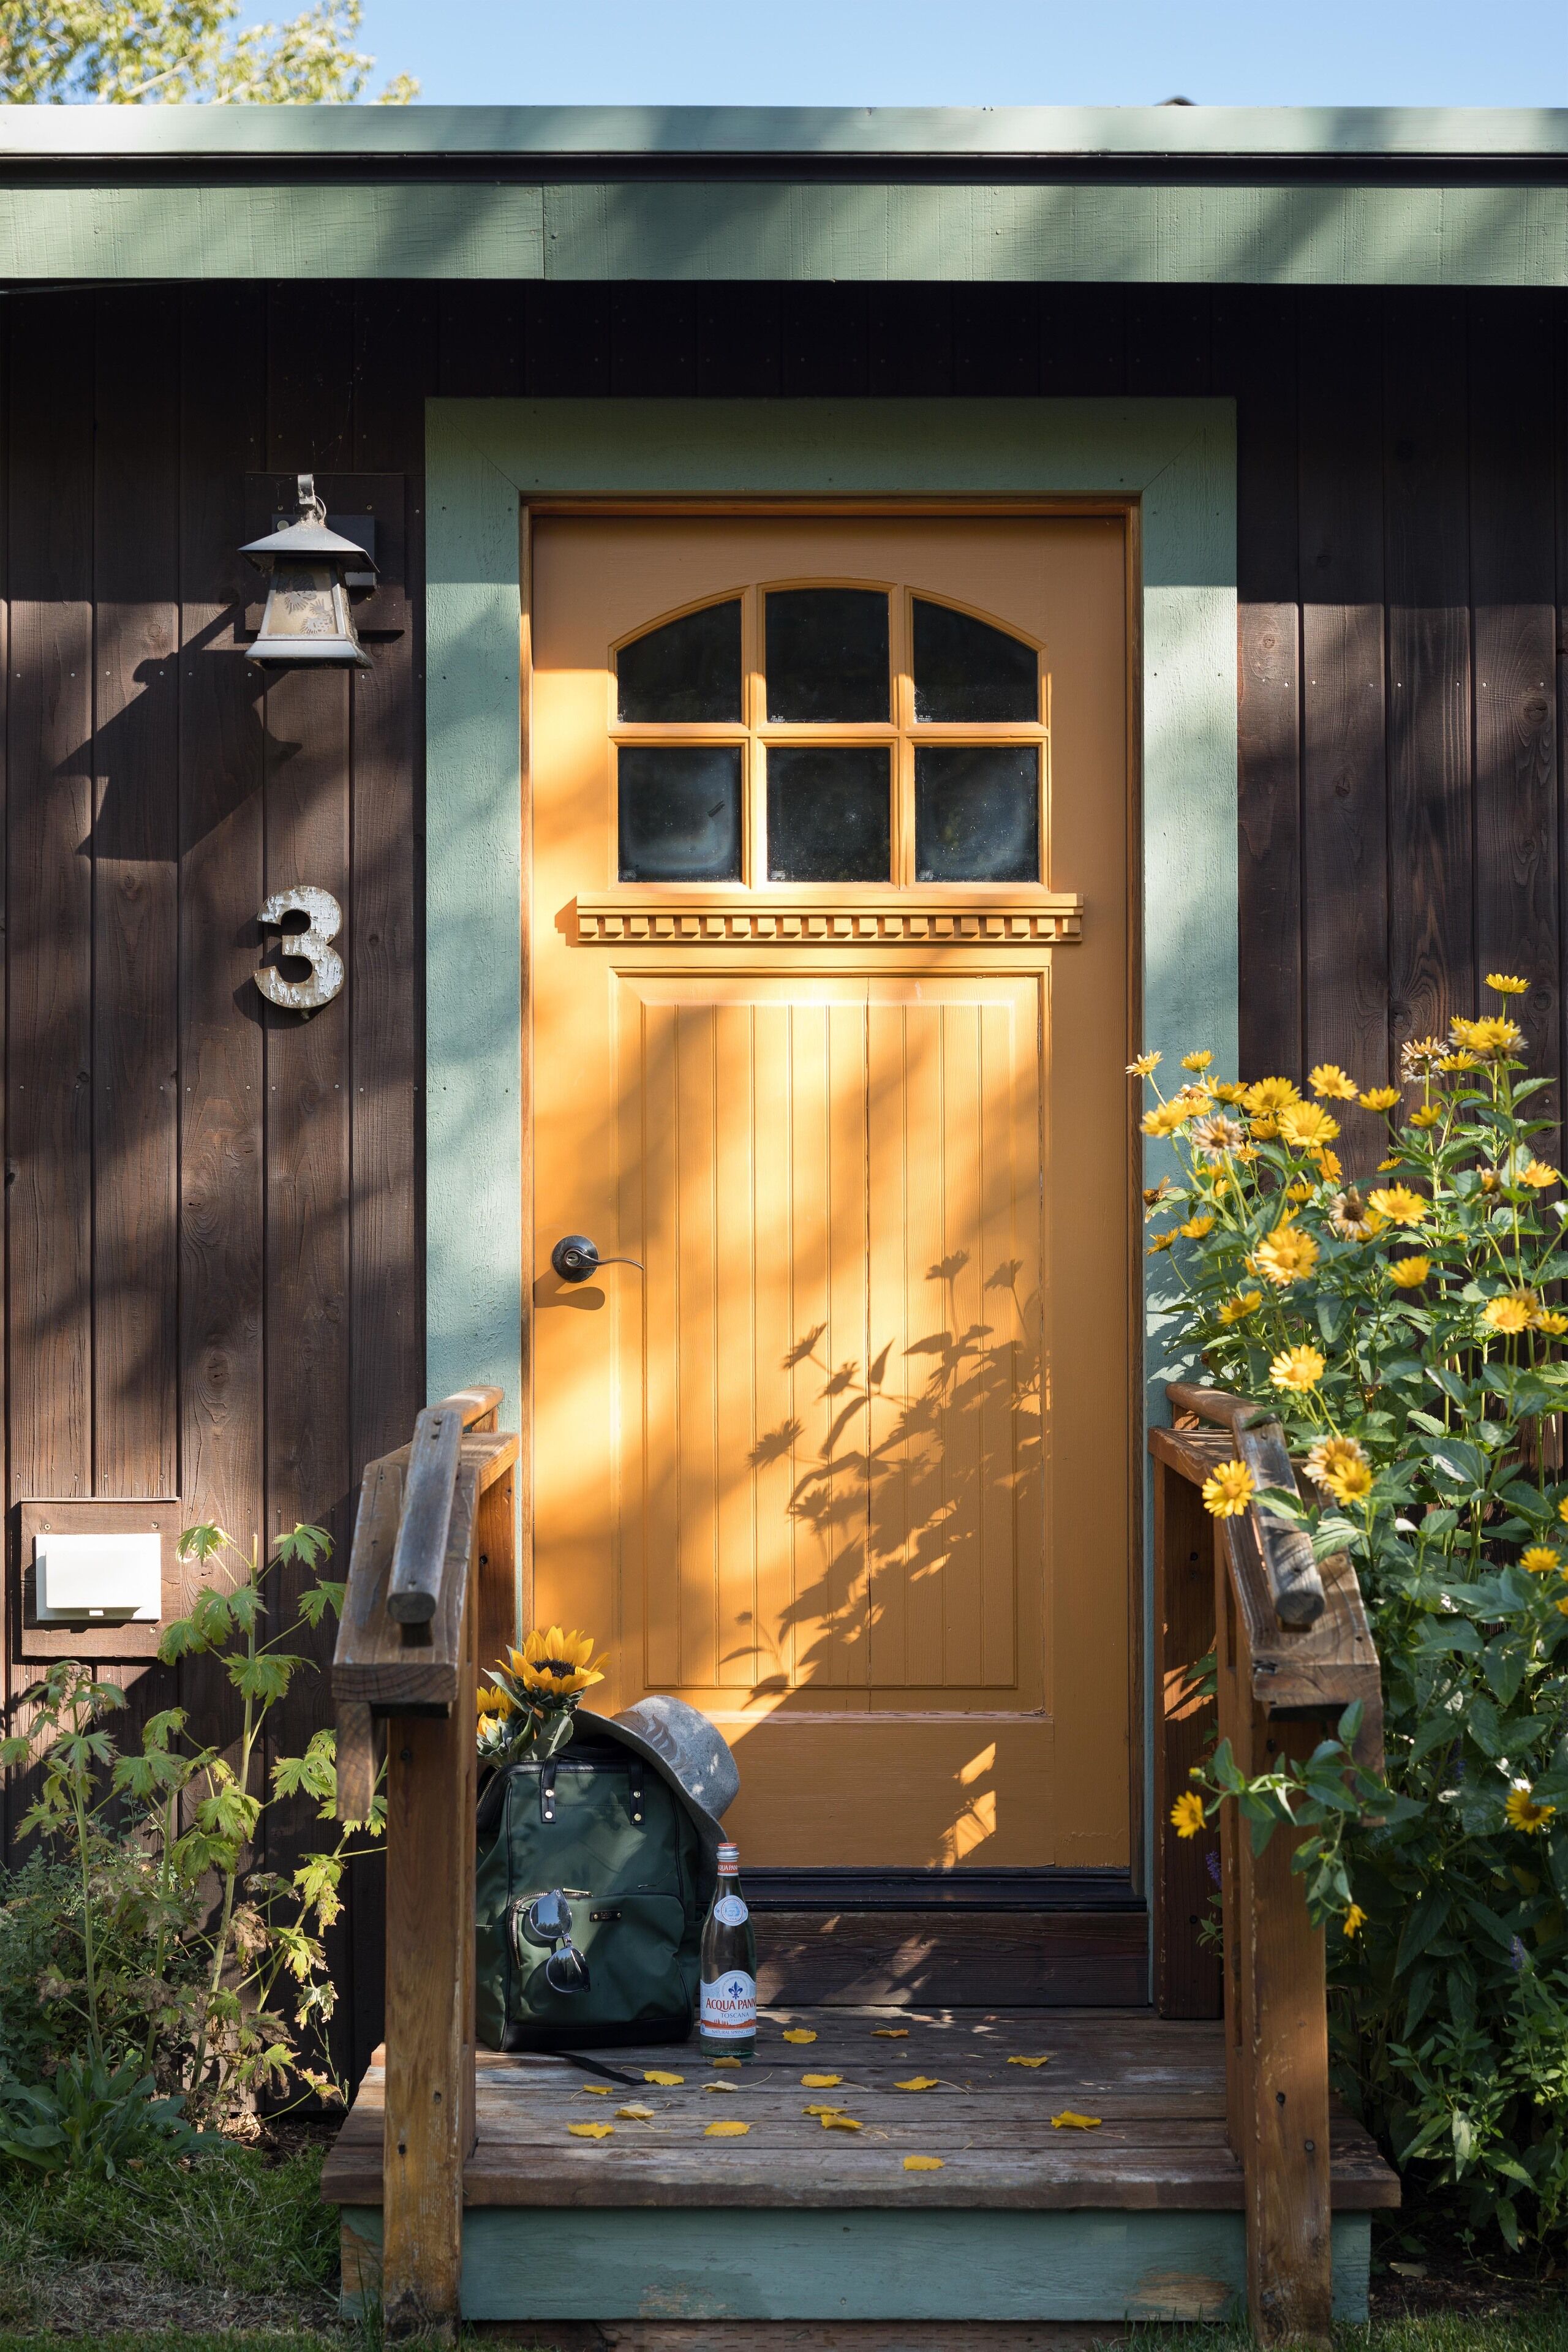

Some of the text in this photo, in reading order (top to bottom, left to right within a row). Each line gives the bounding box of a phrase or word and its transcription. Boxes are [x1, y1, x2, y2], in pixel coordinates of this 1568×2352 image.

[253, 885, 345, 1009] 3
[706, 1997, 736, 2012] ACQUA
[737, 1997, 755, 2010] PANN
